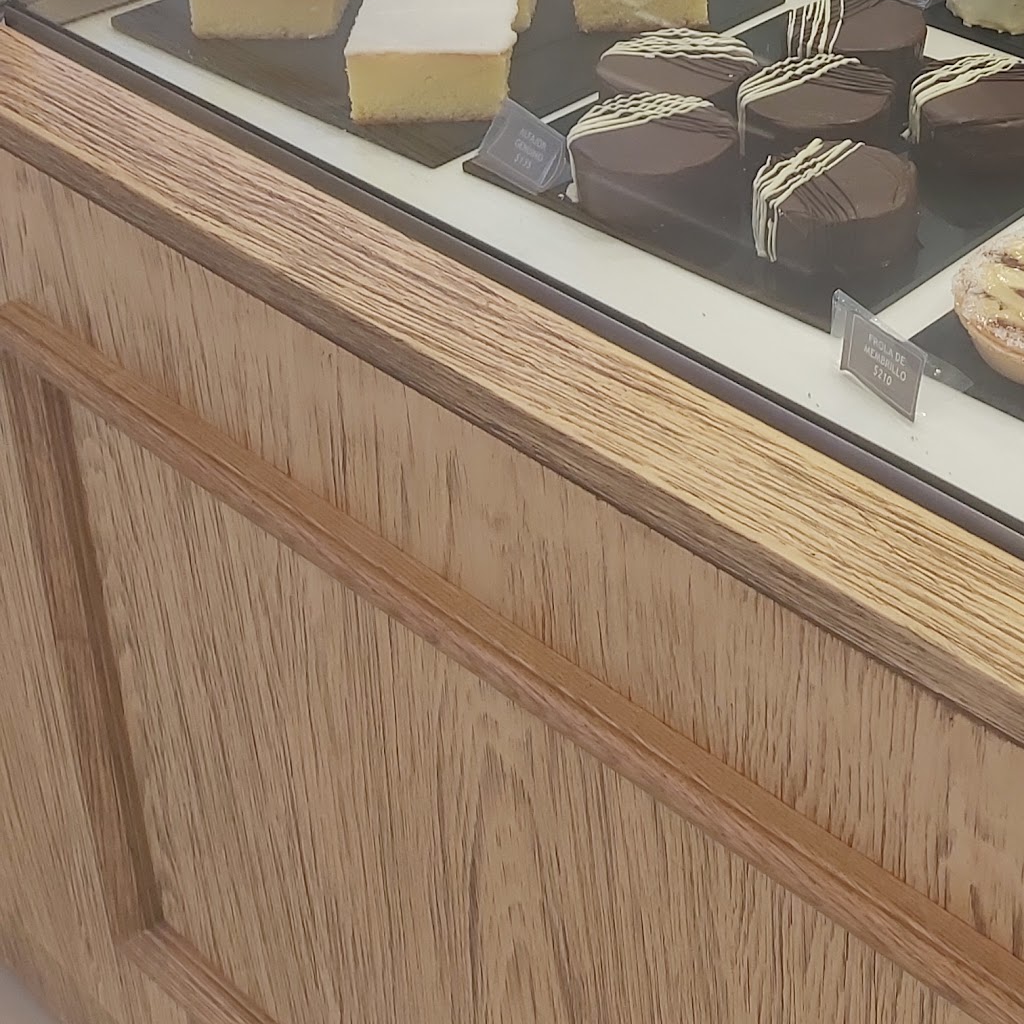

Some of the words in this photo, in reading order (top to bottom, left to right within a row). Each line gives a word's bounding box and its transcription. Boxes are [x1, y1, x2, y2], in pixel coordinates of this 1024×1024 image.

[863, 344, 907, 382] MEMBRILLO
[868, 333, 894, 358] FROLA
[895, 352, 906, 367] DE
[873, 364, 893, 386] $210
